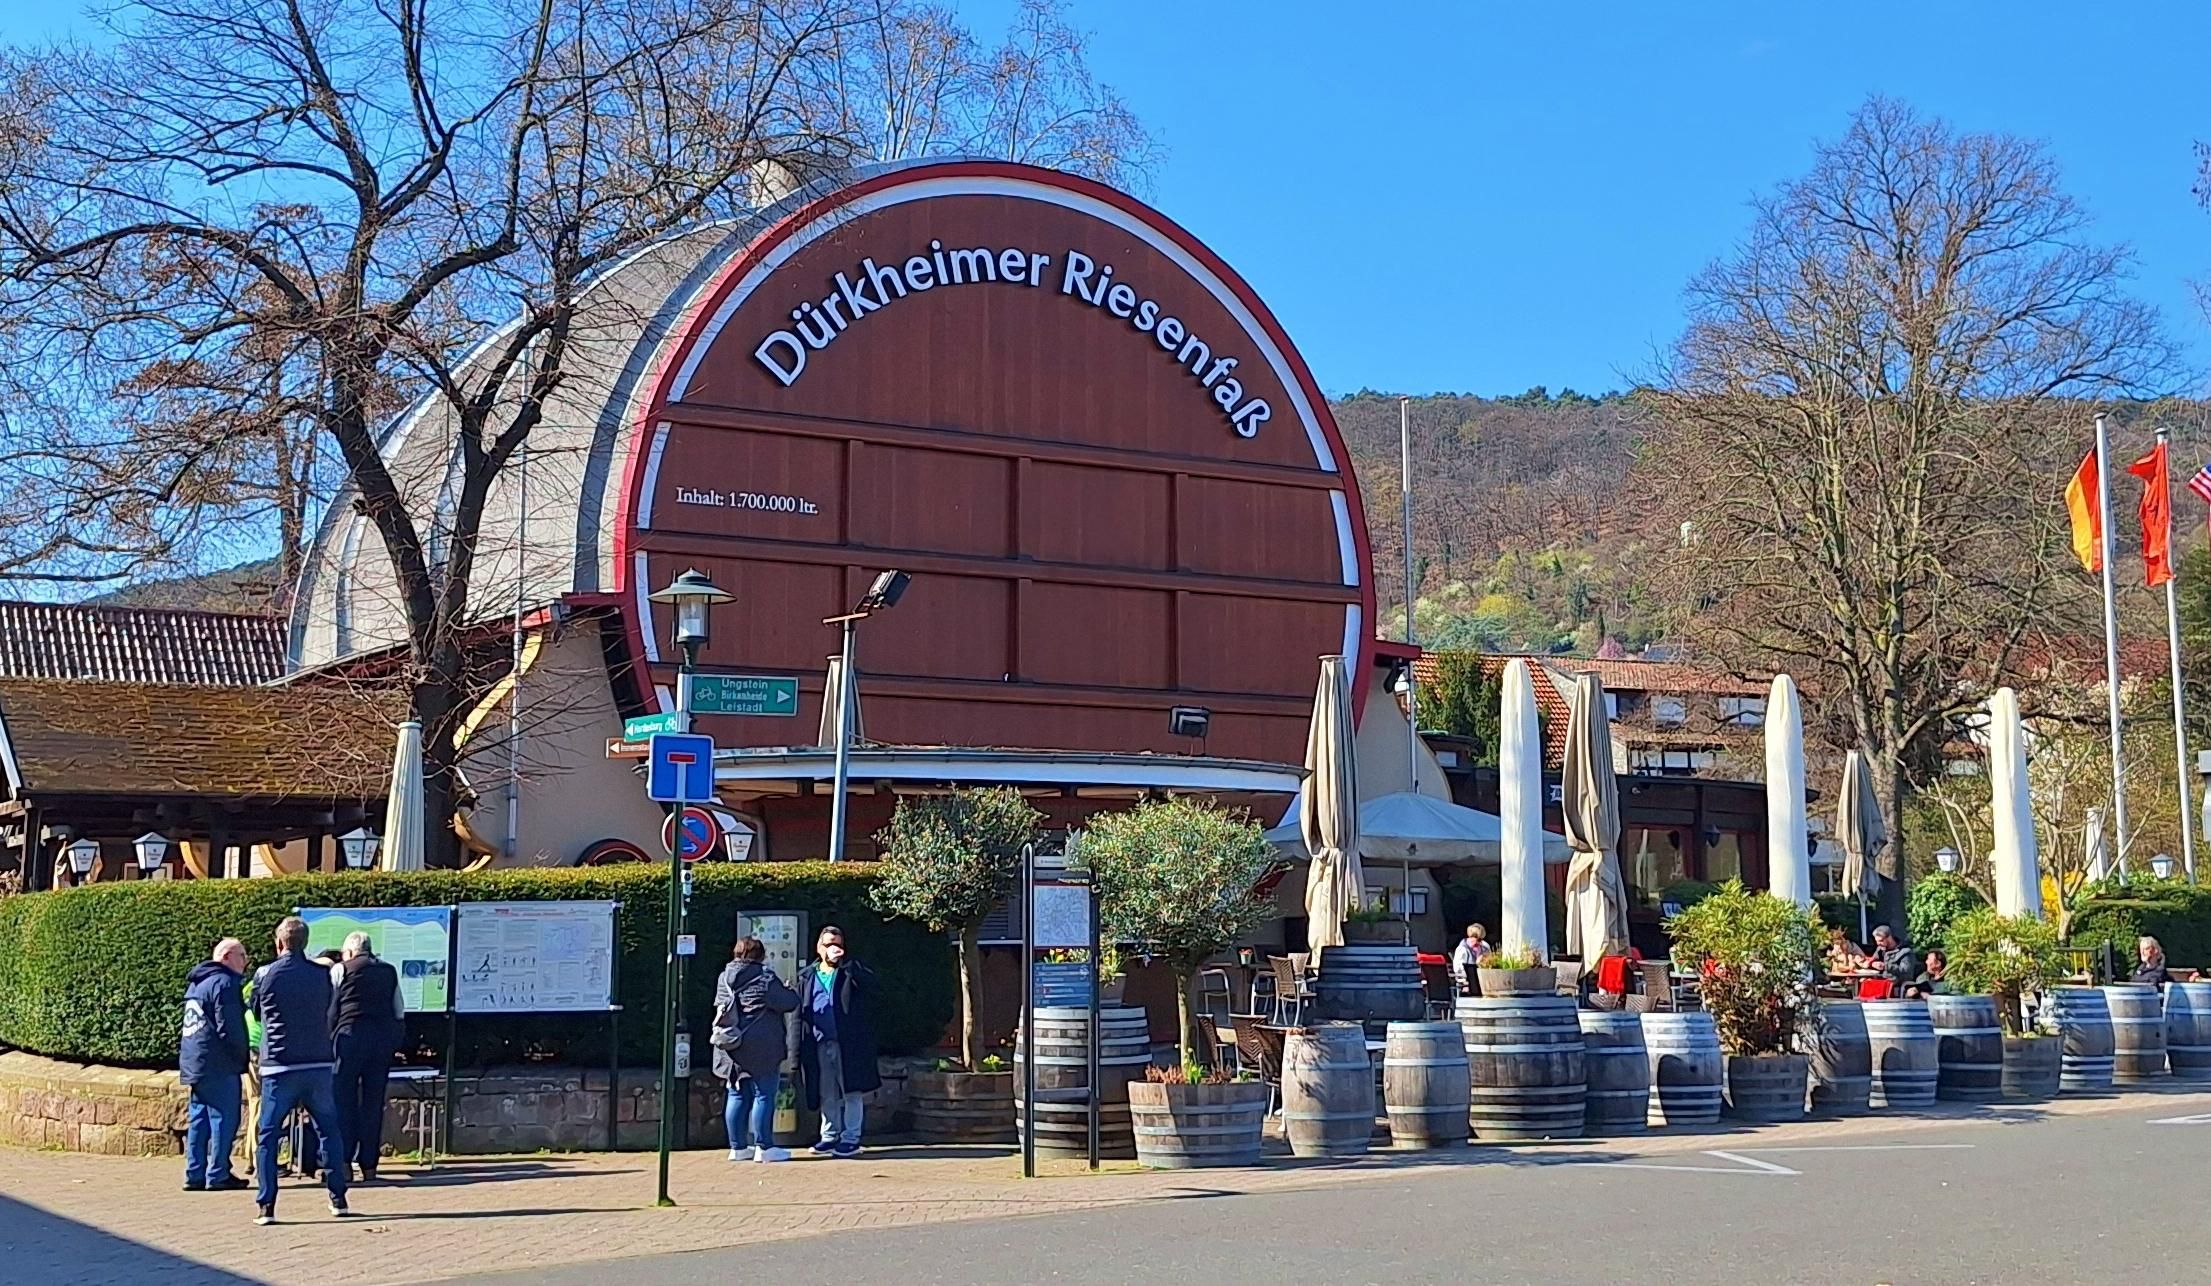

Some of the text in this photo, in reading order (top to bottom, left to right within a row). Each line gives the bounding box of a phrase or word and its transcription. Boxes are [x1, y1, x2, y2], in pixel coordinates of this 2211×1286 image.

[754, 239, 1272, 438] Dürkheimer Riesenfaß
[675, 486, 819, 514] Inhalt: 1.700.000 ltr.
[721, 677, 769, 691] Ungstein
[720, 700, 763, 713] Leistadt
